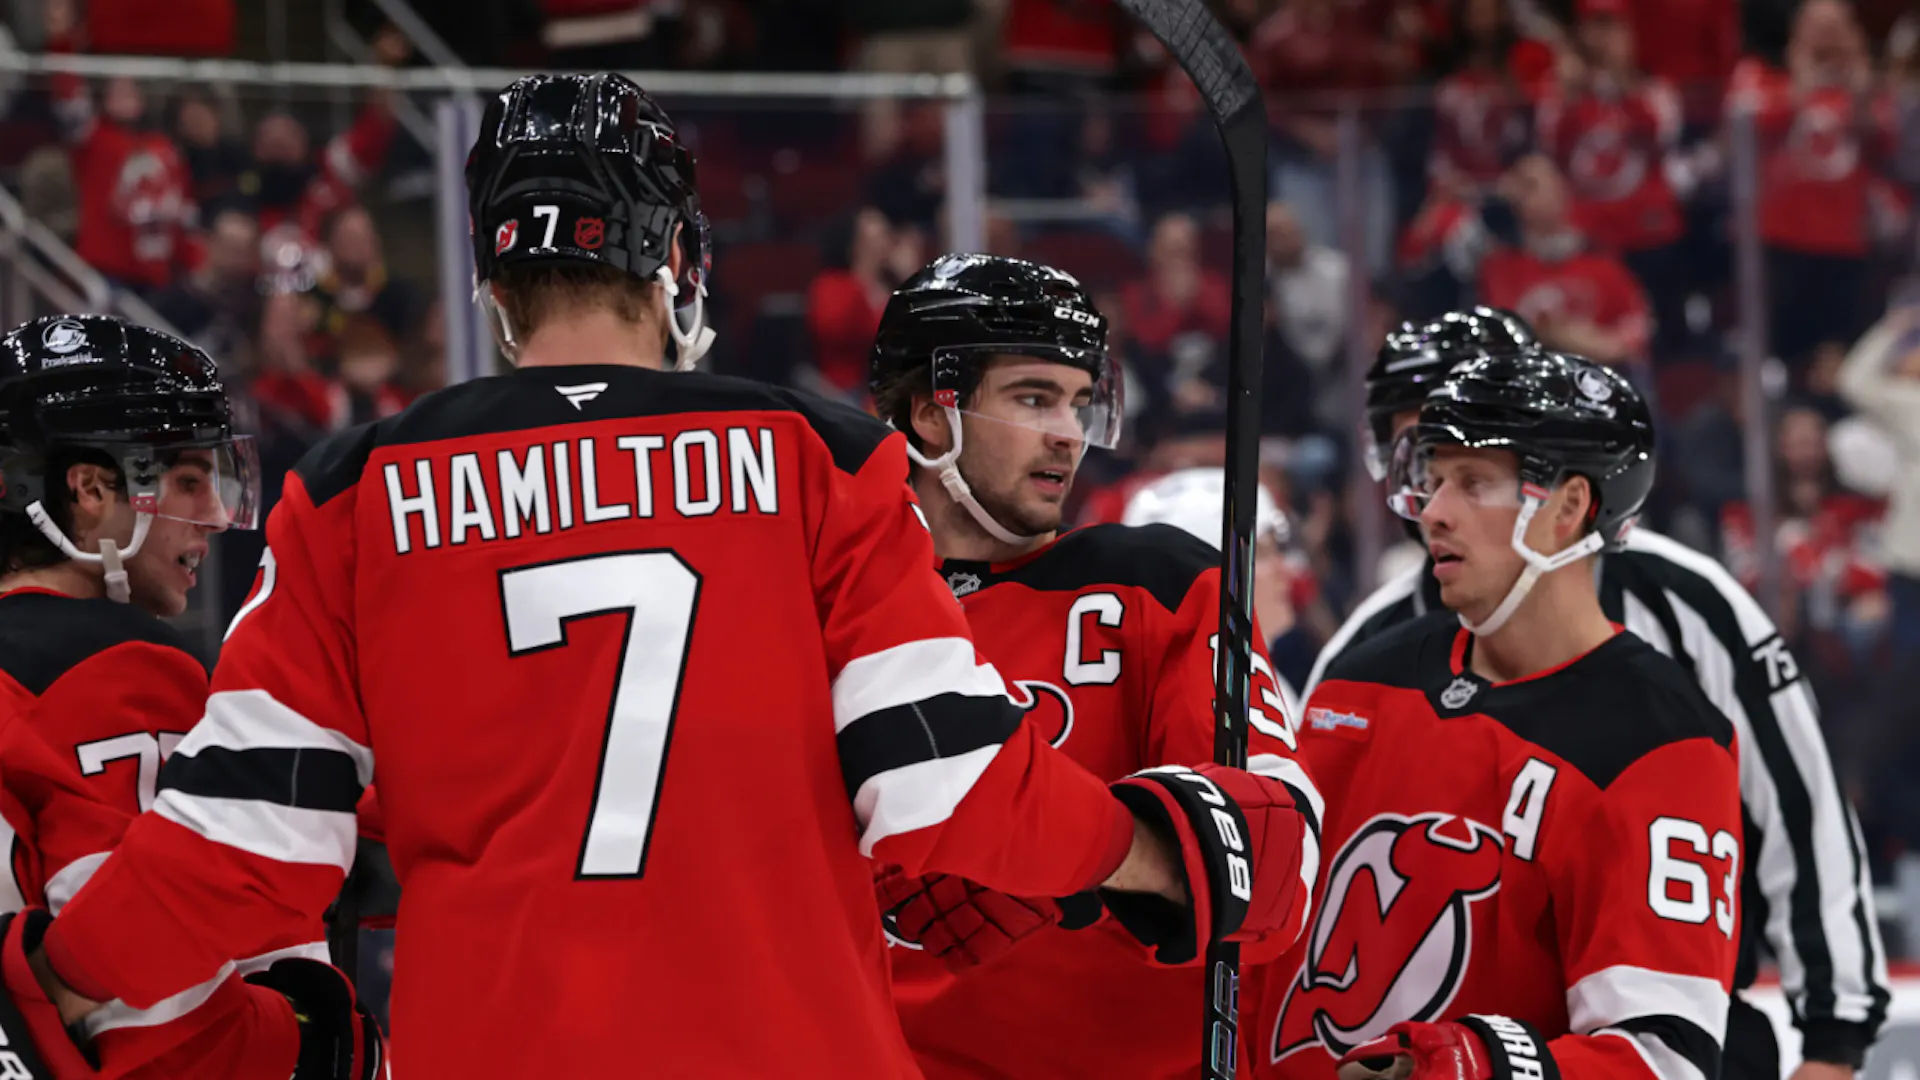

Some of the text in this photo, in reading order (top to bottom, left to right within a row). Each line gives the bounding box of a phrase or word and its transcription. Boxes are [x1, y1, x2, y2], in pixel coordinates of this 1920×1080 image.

[533, 205, 559, 248] 7
[1054, 306, 1100, 328] CCM
[384, 426, 780, 555] HAMILTON
[1063, 592, 1125, 686] C
[1751, 636, 1799, 688] 75
[497, 548, 703, 880] 7
[75, 729, 188, 814] 7
[1502, 756, 1557, 862] A
[1150, 764, 1252, 902] BAU
[1647, 815, 1739, 941] 63
